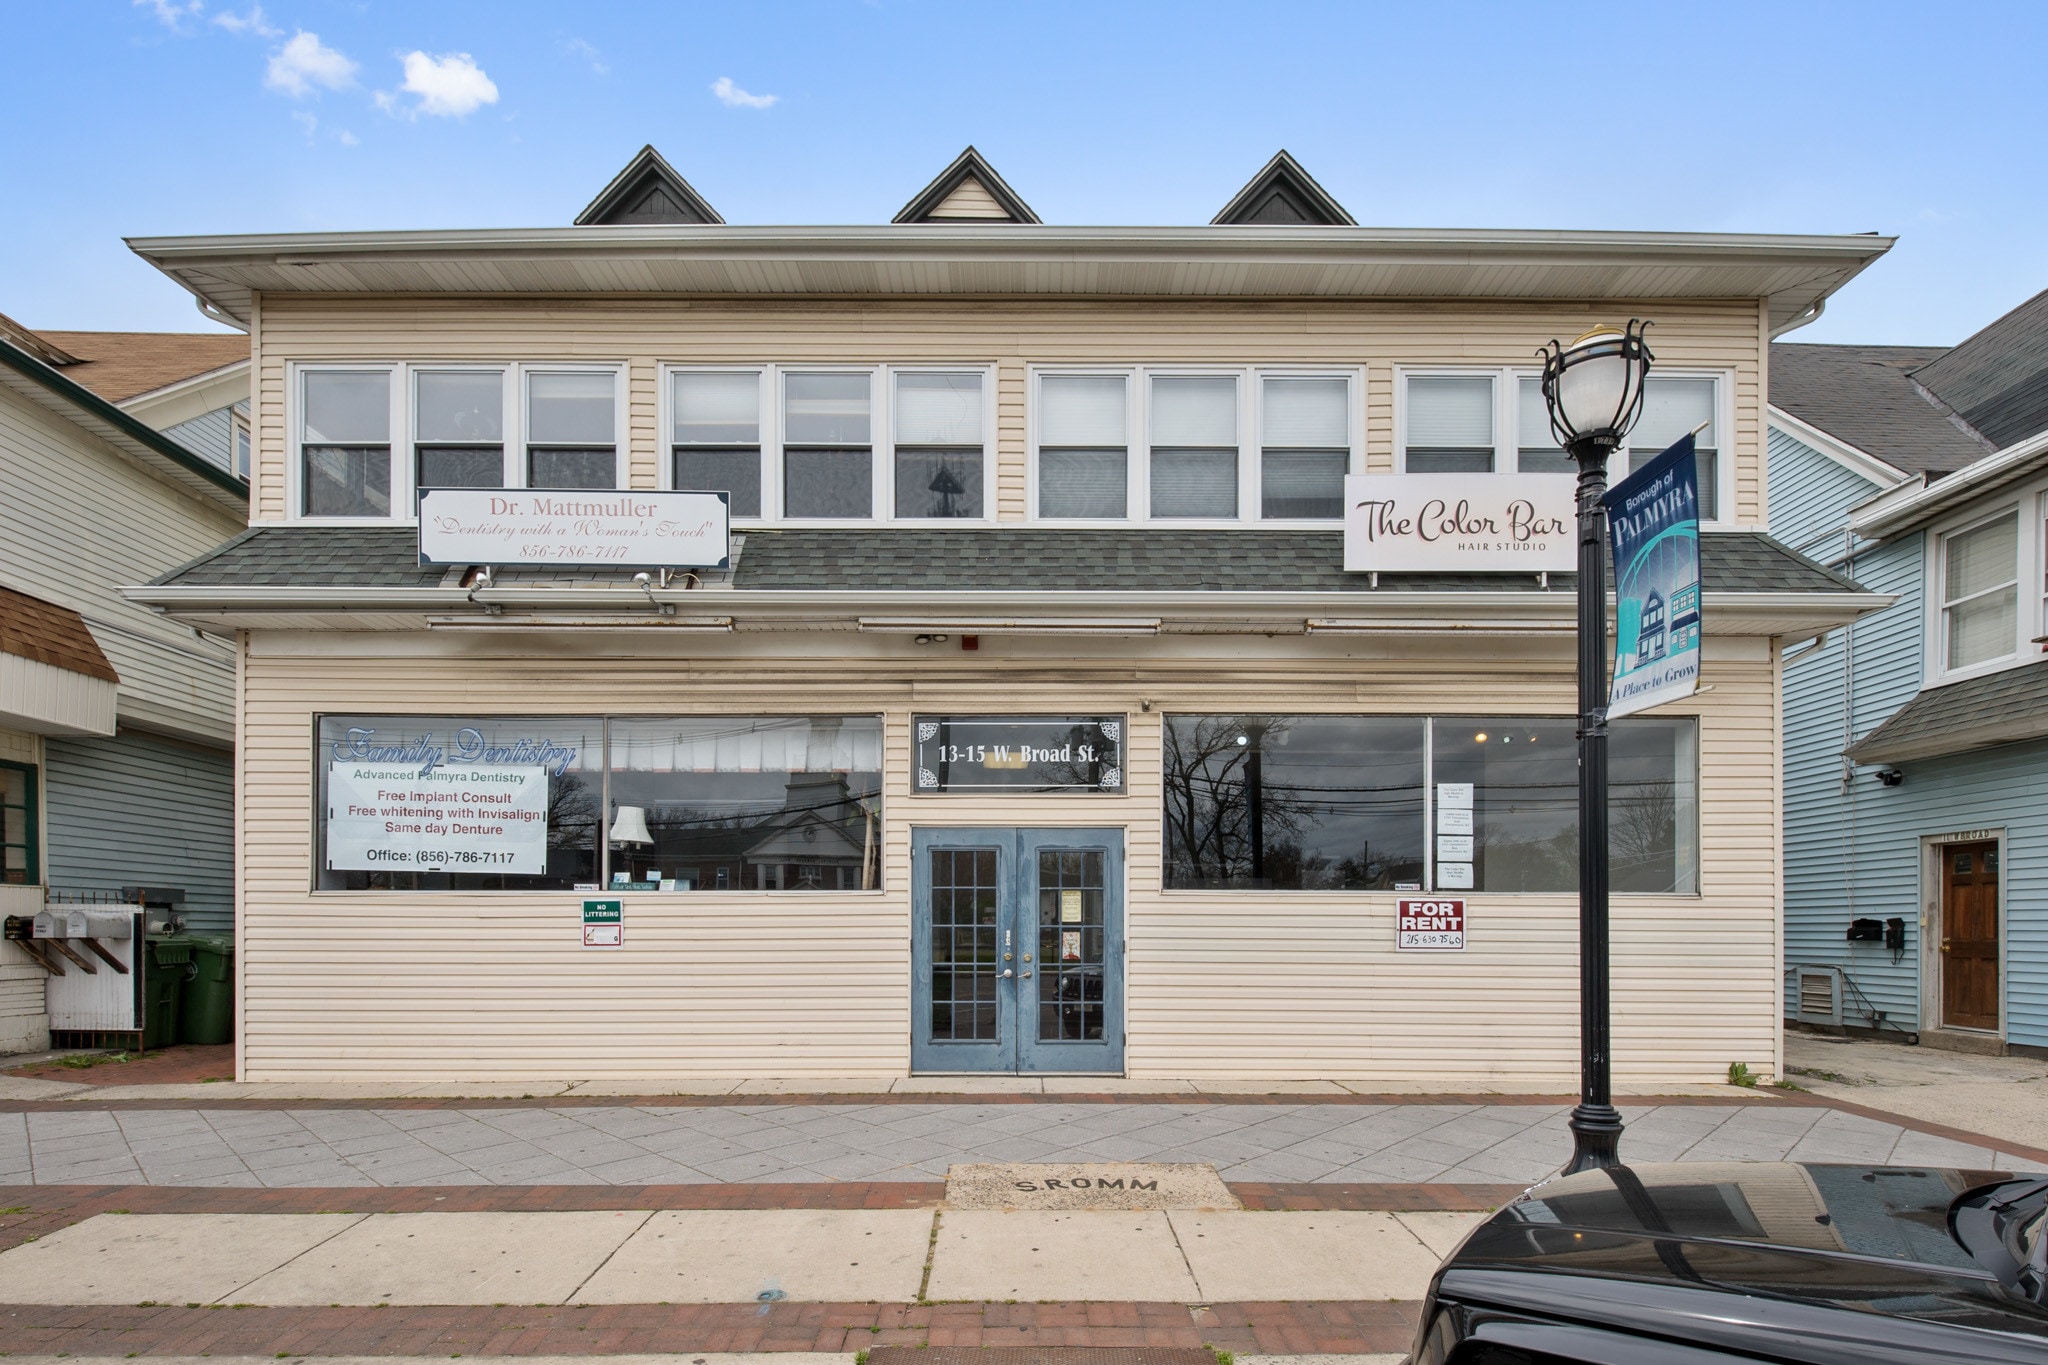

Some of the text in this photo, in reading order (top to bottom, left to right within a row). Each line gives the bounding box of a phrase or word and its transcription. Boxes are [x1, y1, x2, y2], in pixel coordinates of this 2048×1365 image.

[1625, 468, 1674, 511] Borough of
[489, 498, 657, 518] Dr. Mattmuller
[516, 521, 553, 536] with
[557, 528, 567, 536] a
[573, 520, 648, 538] Woman's
[1356, 499, 1568, 543] The Color Bar
[519, 545, 630, 559] 856-786-7117
[1458, 542, 1546, 551] HAIR STUDIO
[1613, 664, 1697, 700] A Place to Grow
[332, 727, 577, 778] Family Dentistry
[938, 744, 1100, 763] 13-15 W. Broad St.
[353, 769, 526, 785] Advanced Palmyra Dentistry
[378, 790, 512, 805] Free Implant Consult
[348, 805, 540, 823] Free whitening with Invisalign
[385, 822, 503, 836] Same day Denture
[1960, 829, 1990, 840] BROAD
[366, 849, 515, 865] Office: (856)-786-7117
[1408, 902, 1454, 916] FOR
[1401, 917, 1462, 930] RENT
